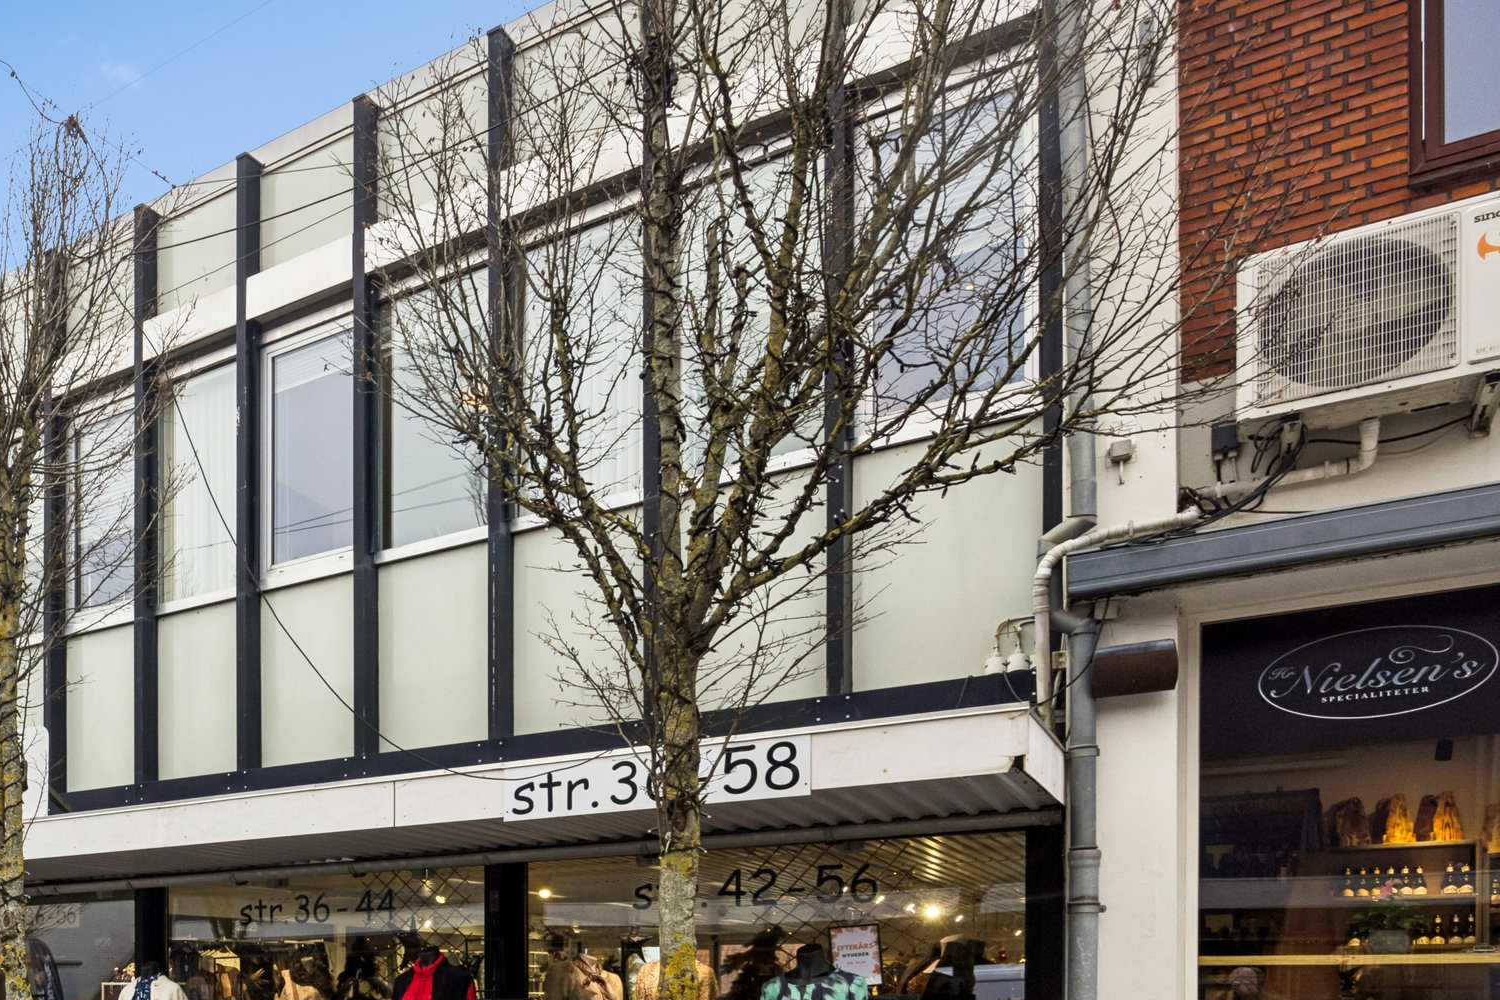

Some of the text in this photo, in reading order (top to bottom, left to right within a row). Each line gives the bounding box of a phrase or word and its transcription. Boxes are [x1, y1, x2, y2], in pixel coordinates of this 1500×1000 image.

[1270, 652, 1485, 698] Nielsen's
[1320, 685, 1430, 704] SPECIALITETER
[511, 741, 801, 816] str.3-58
[841, 951, 870, 959] NYHEDER
